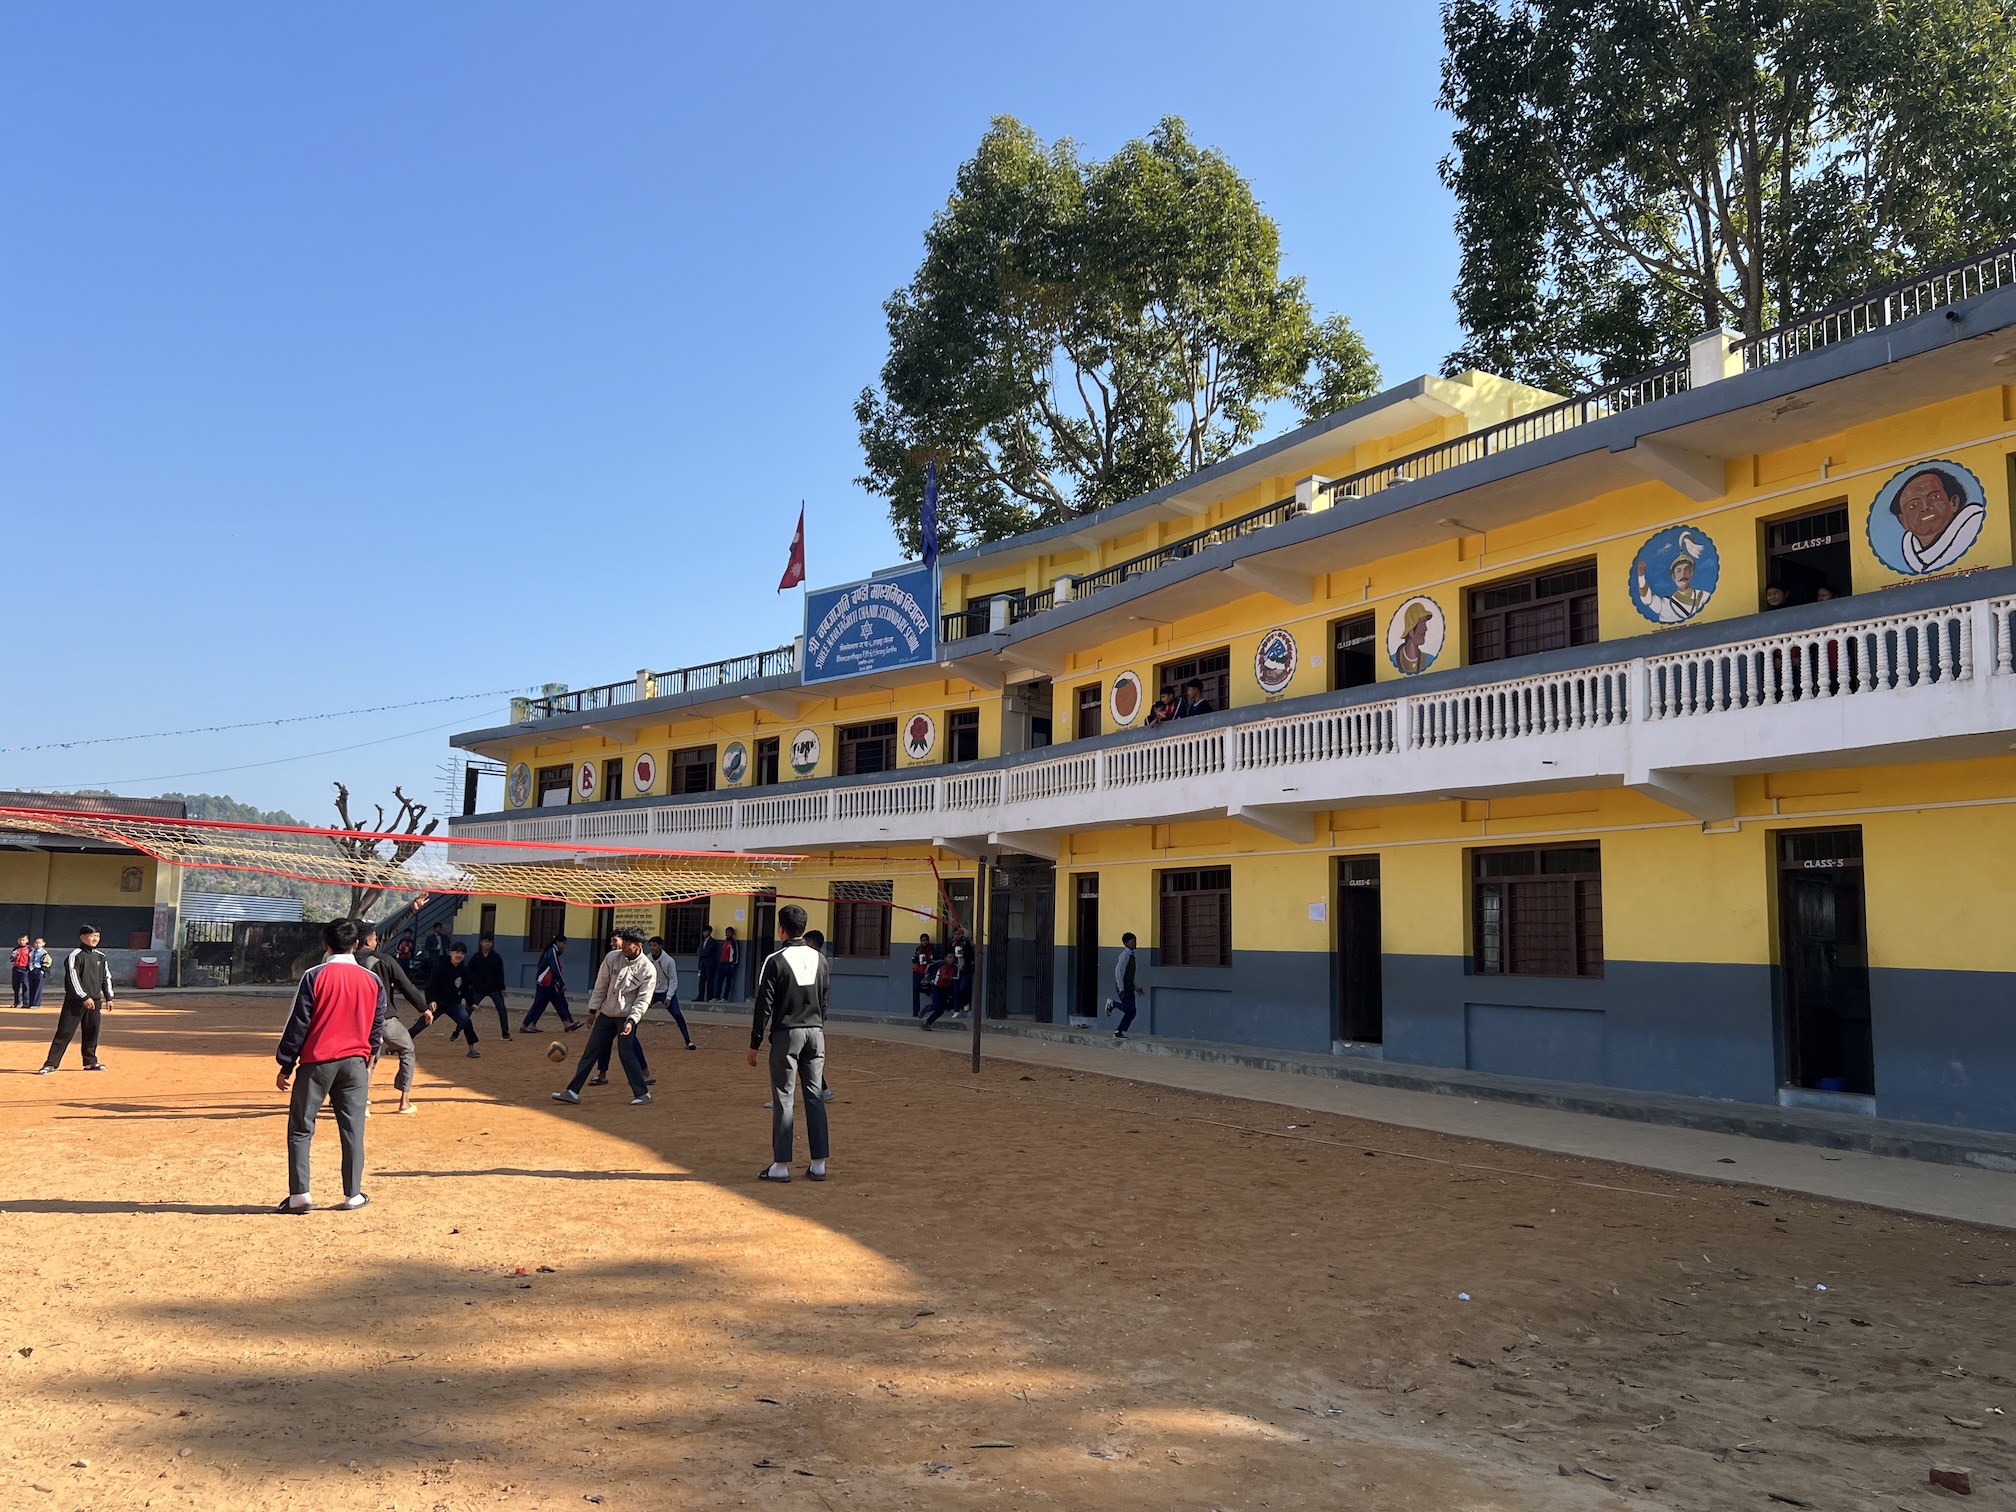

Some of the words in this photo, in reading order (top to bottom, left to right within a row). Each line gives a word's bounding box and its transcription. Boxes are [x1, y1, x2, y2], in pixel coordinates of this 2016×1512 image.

[1791, 535, 1831, 551] CLASS-8
[808, 636, 820, 655] श्री
[870, 583, 905, 606] माध्यमिक
[902, 593, 929, 635] विद्यालय
[815, 643, 831, 670] SHREE
[879, 605, 909, 633] SECONDARY
[903, 626, 920, 654] SCHOOL
[1803, 859, 1844, 868] CLASS-5
